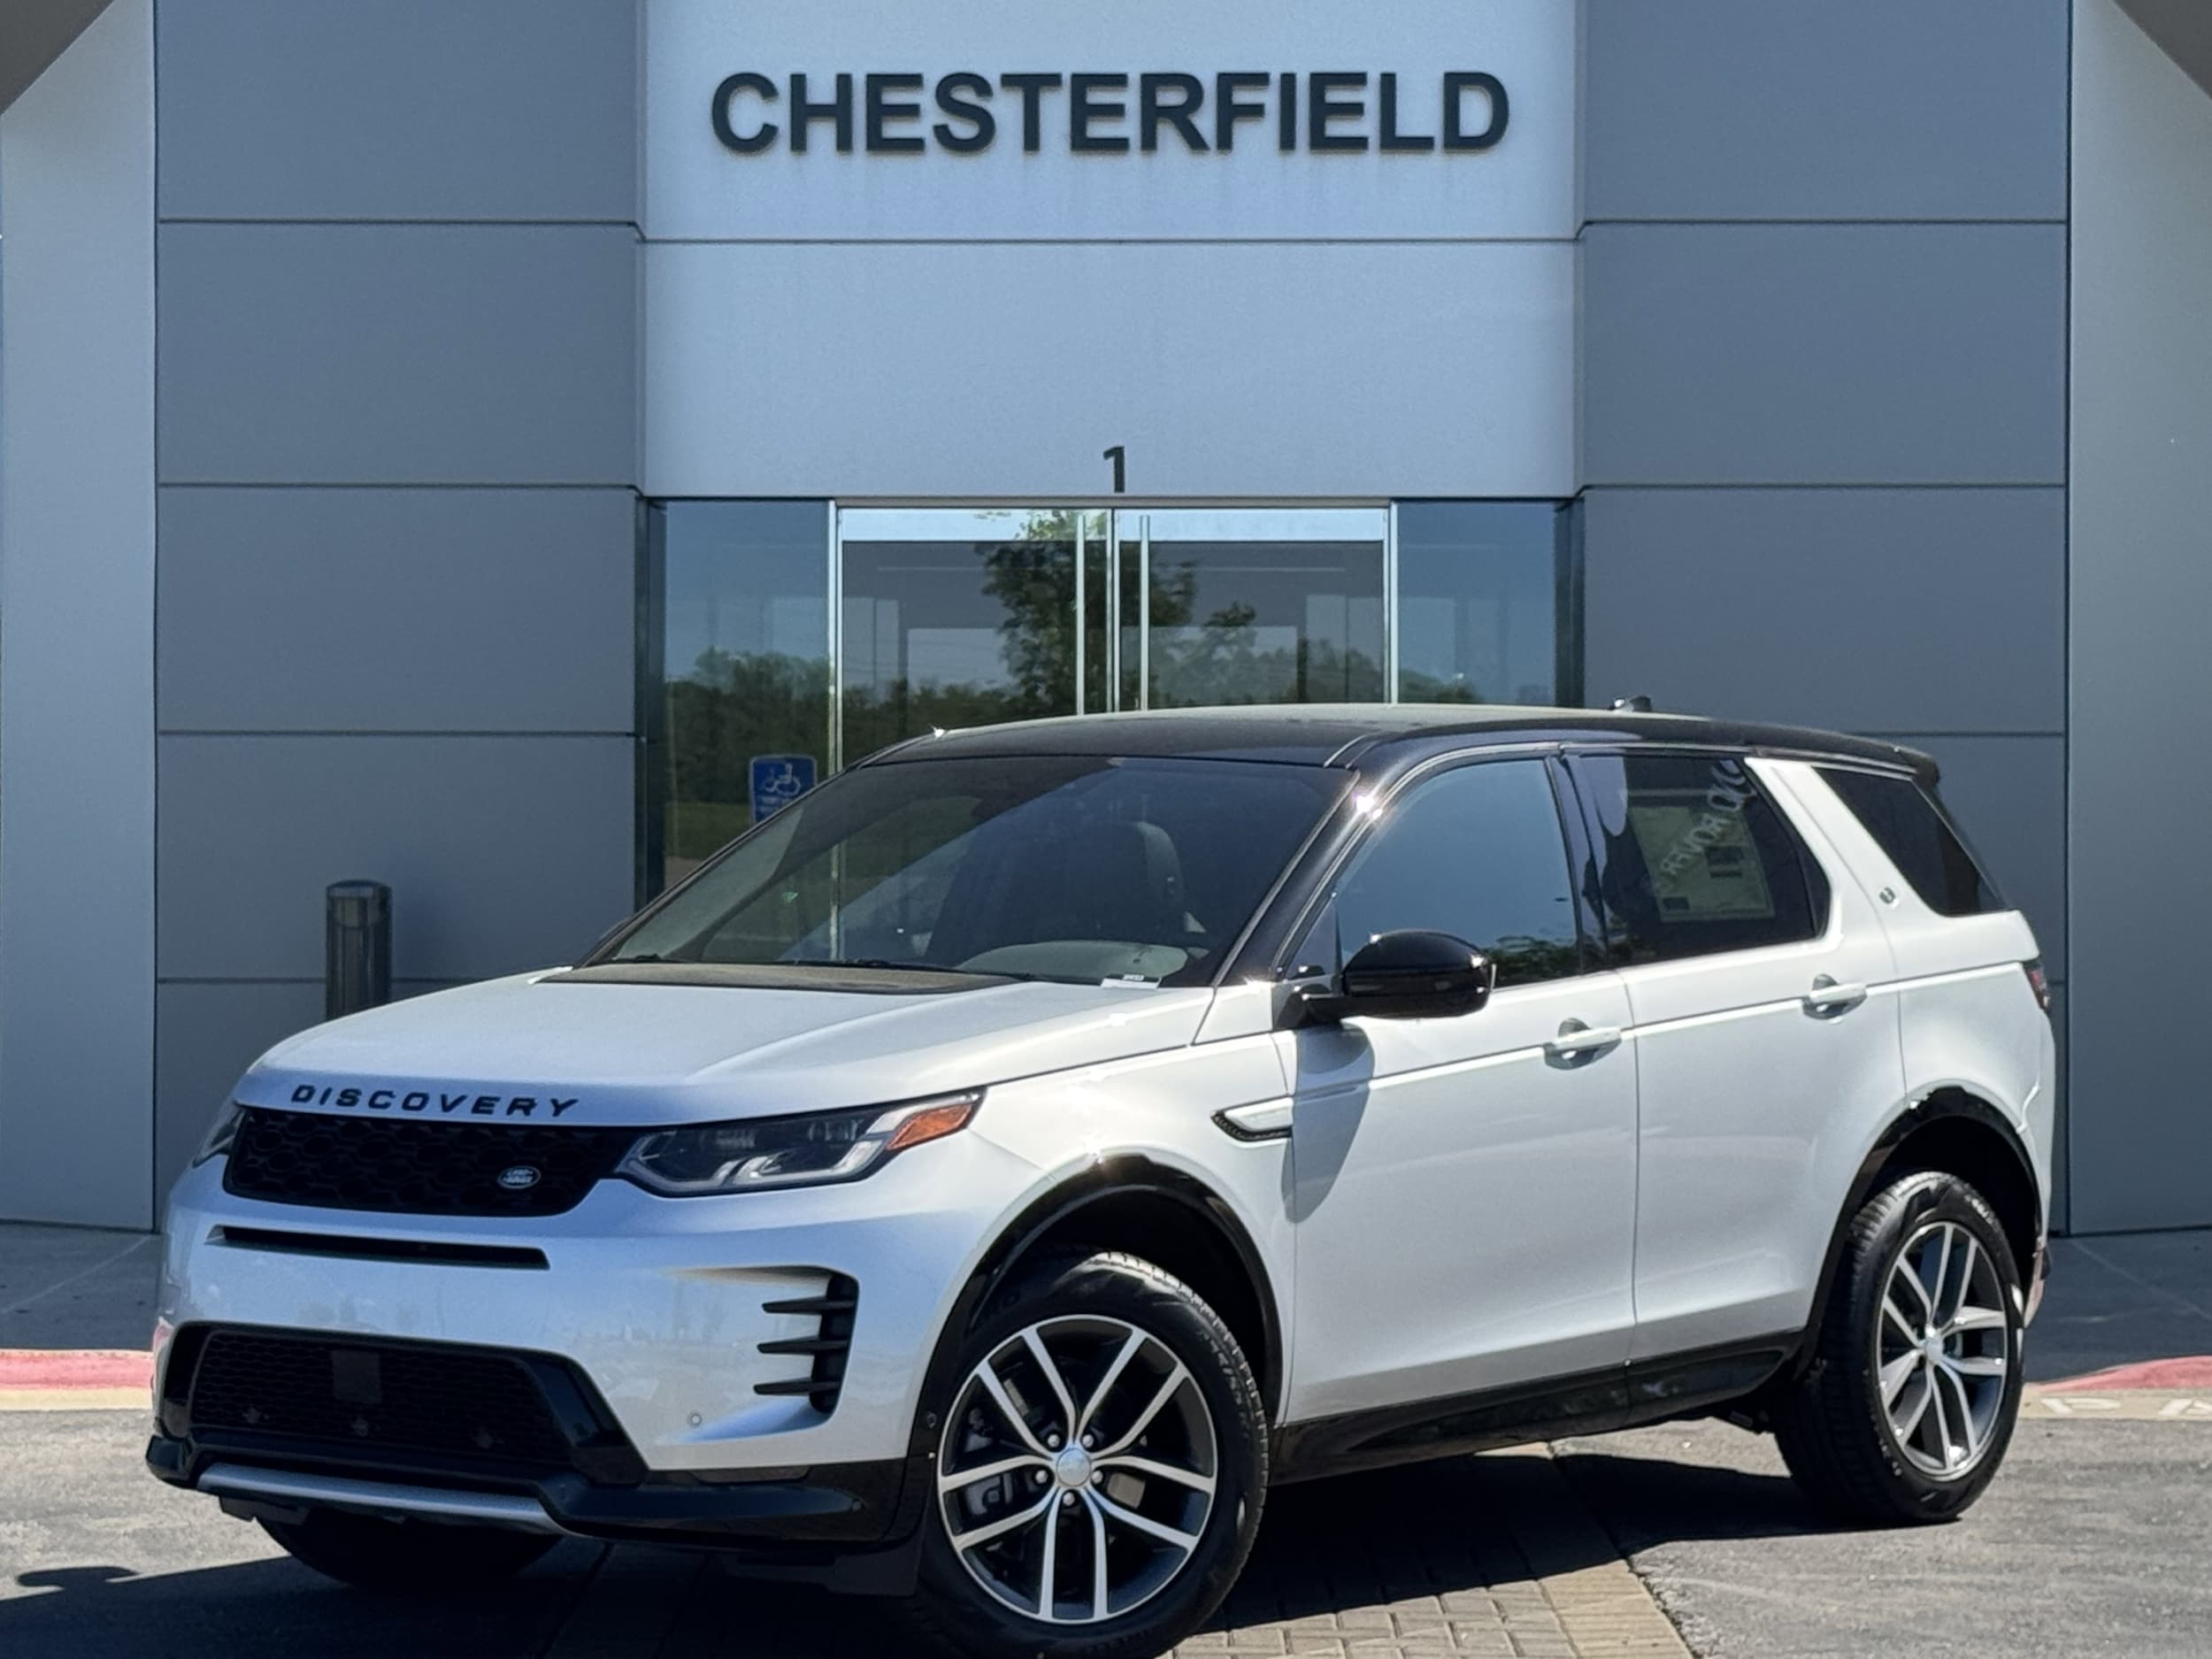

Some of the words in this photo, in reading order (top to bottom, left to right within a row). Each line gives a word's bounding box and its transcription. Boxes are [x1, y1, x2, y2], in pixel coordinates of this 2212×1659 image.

[711, 71, 1510, 153] CHESTERFIELD
[1102, 445, 1125, 493] 1
[290, 1084, 580, 1118] DISCOVERY
